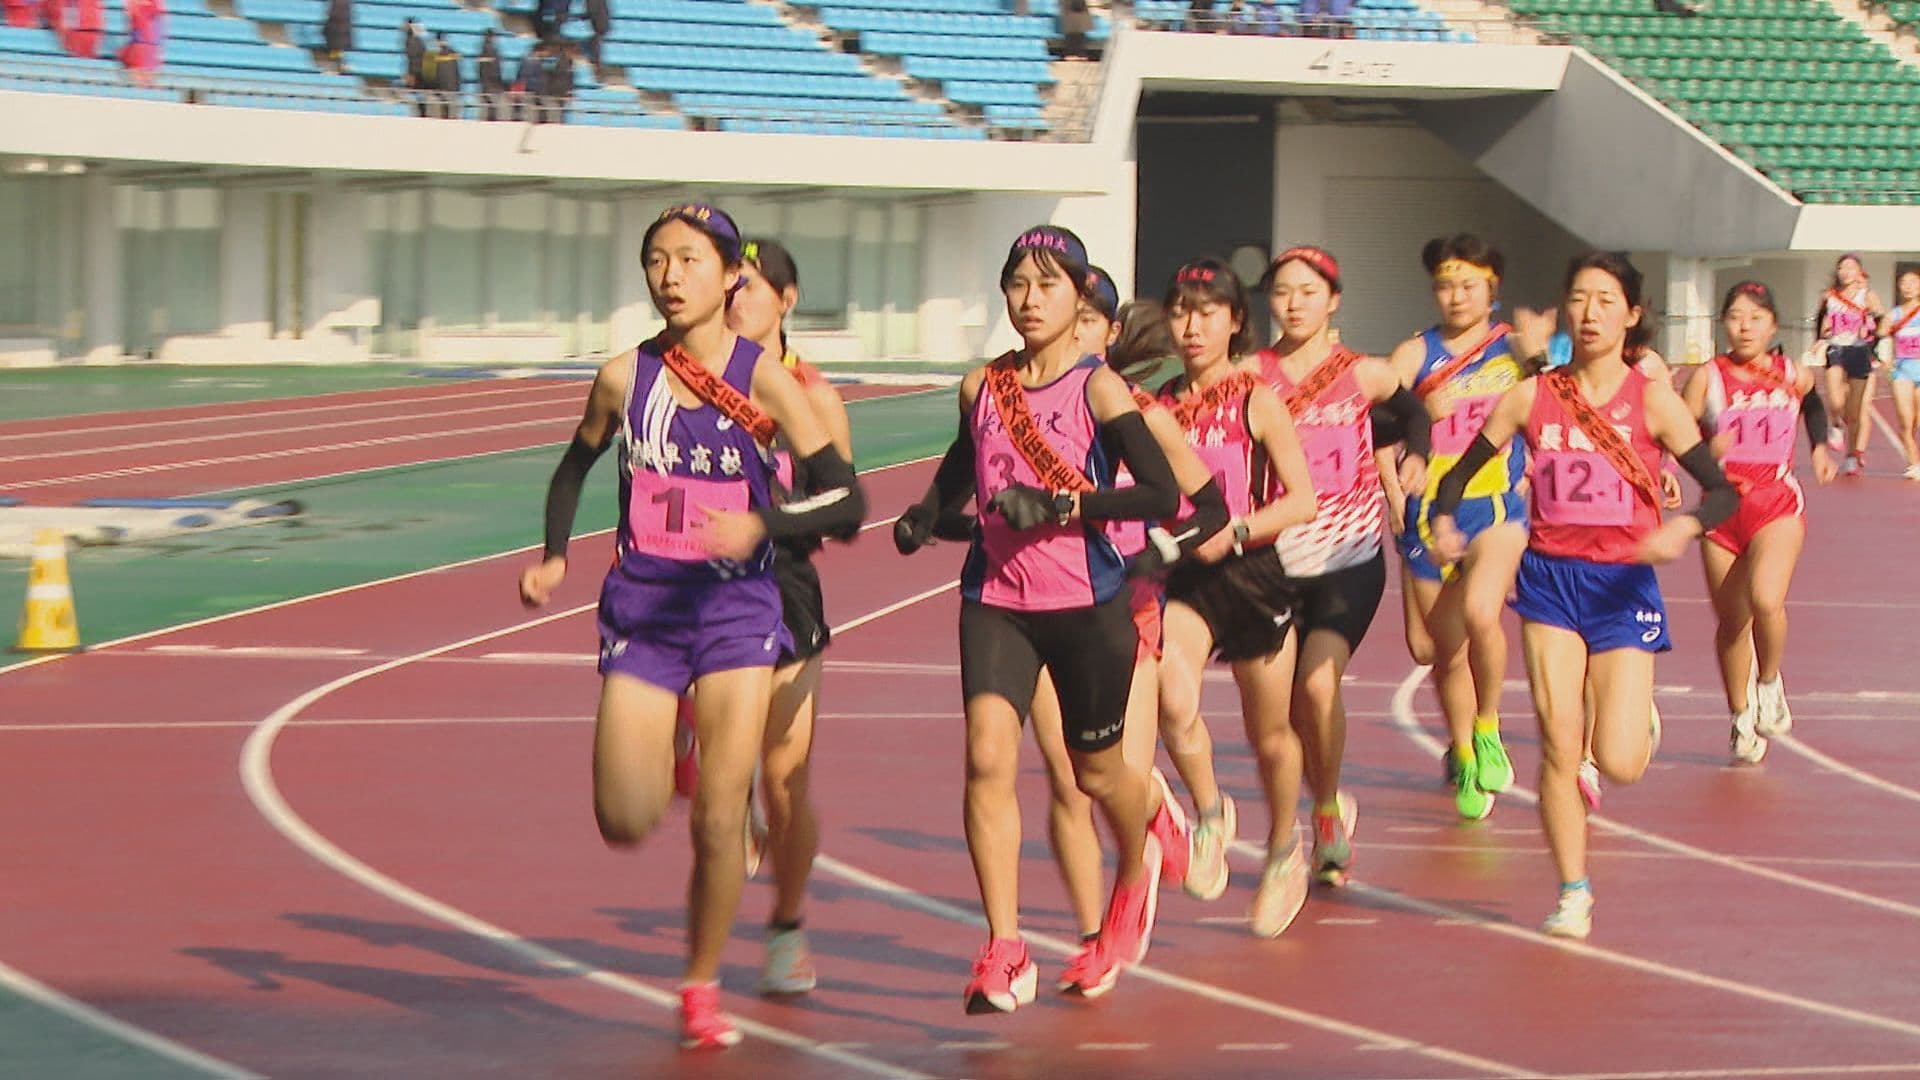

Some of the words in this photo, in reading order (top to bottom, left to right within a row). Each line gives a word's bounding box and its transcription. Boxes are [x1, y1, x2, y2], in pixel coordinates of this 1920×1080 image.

[1308, 49, 1332, 70] 4
[1339, 60, 1393, 78] GATE
[988, 452, 1016, 493] 3
